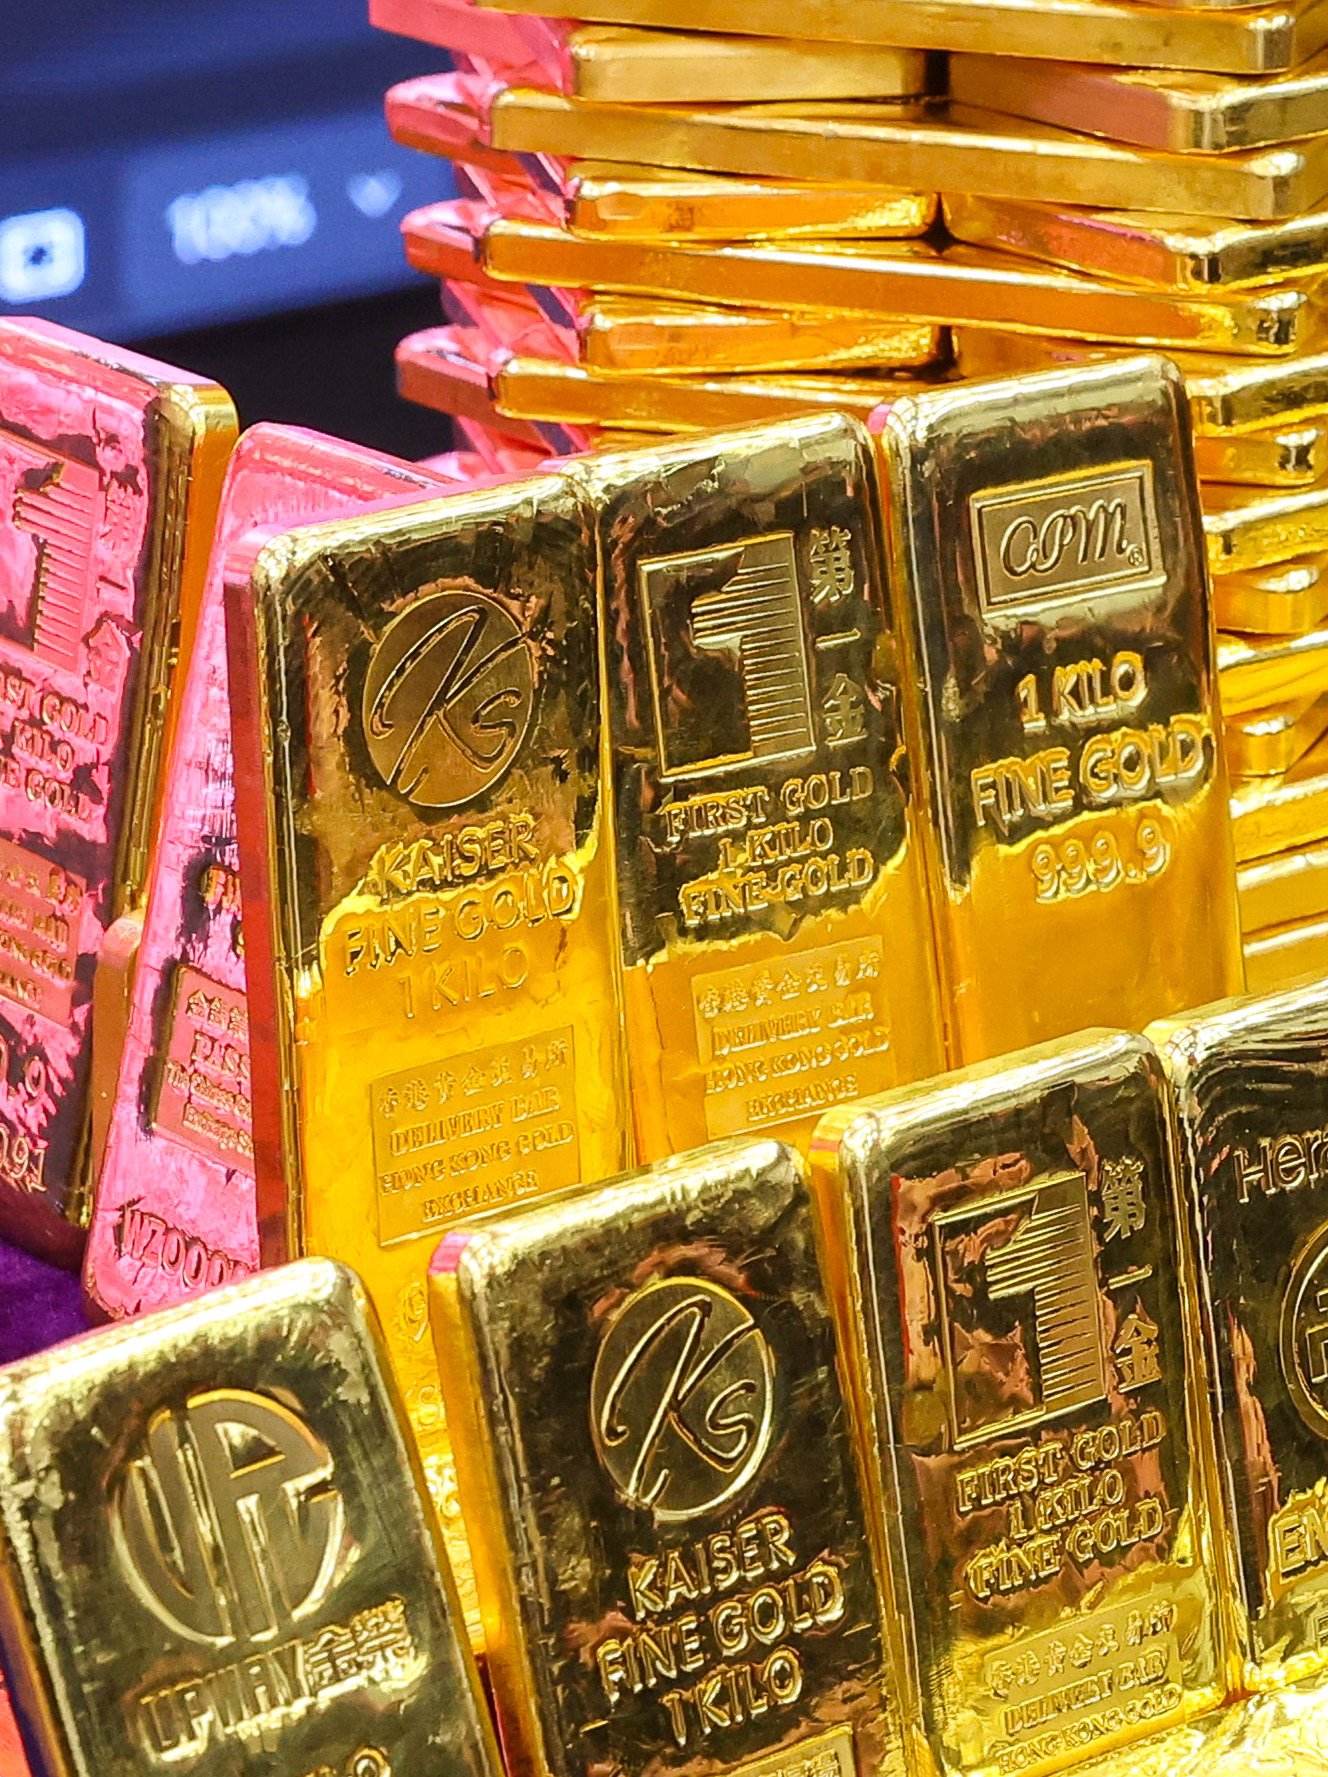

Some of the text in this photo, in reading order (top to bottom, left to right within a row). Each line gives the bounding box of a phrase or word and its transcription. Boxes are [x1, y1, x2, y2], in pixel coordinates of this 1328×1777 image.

[167, 172, 318, 264] 100%
[1017, 651, 1148, 732] 1 KILO
[664, 765, 874, 842] FIRST GOLD
[972, 712, 1213, 827] FINE GOLD
[375, 814, 538, 896] KAISER
[744, 816, 834, 869] KILO
[1031, 818, 1171, 904] 999.9
[342, 862, 580, 976] FINE GOLD
[682, 847, 874, 926] FINE GOLD
[397, 945, 530, 1019] 1 KILO
[377, 1120, 575, 1197] HONG KONG GOLD
[390, 1100, 506, 1157] DELIVERY
[422, 1169, 539, 1223] EXCHANGE
[957, 1409, 1168, 1513] FIRST GOLD
[1036, 1468, 1125, 1530] KILO
[627, 1512, 797, 1619] KAISER
[966, 1497, 1164, 1600] FINE GOLD
[597, 1563, 845, 1703] FINE GOLD
[660, 1645, 803, 1749] 1 KILO
